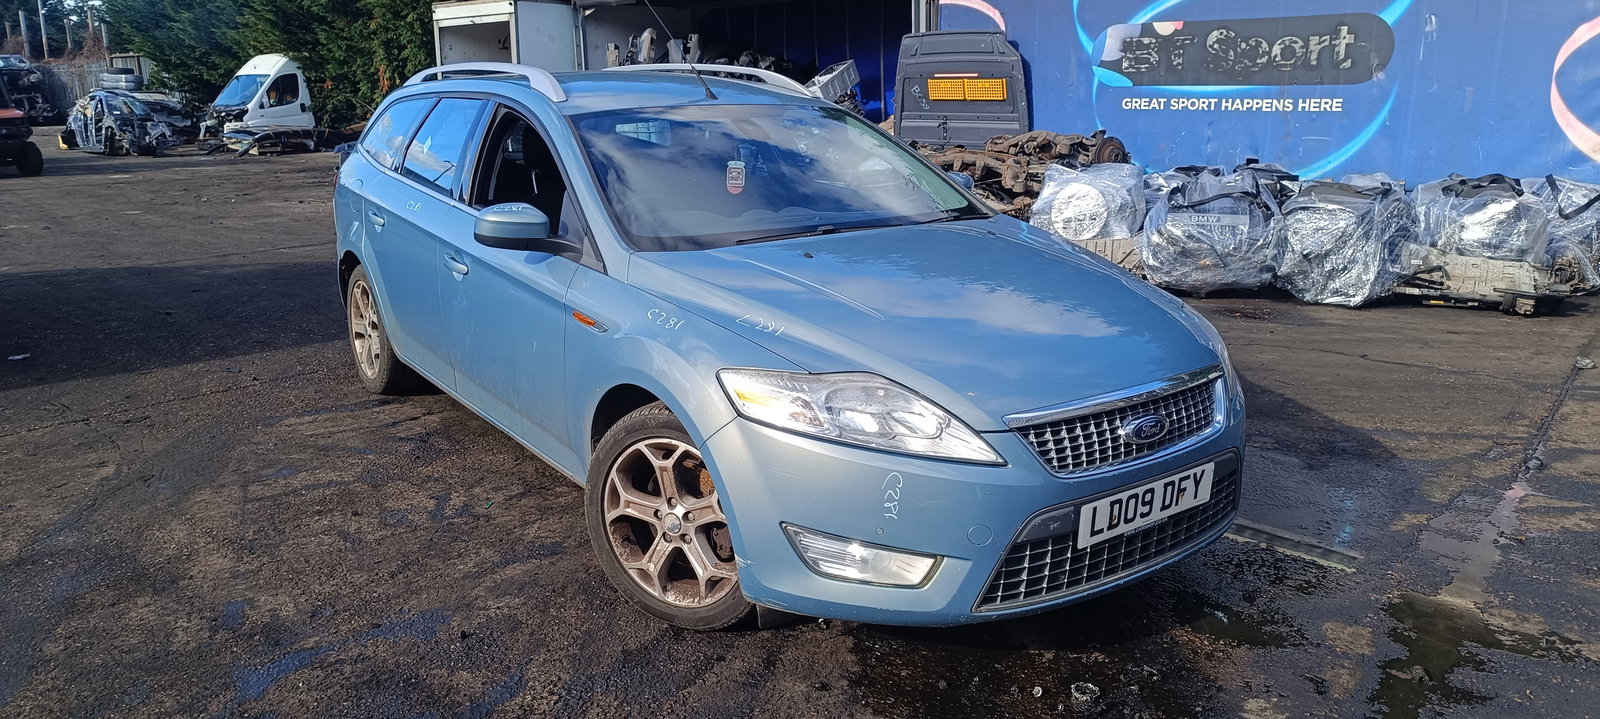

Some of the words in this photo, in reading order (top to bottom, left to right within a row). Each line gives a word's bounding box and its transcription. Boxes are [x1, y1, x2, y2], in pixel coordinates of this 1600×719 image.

[1204, 26, 1356, 80] Sport
[1121, 98, 1167, 110] GREAT
[1170, 98, 1218, 111] SPORT
[1221, 98, 1294, 112] HAPPENS
[1298, 98, 1343, 112] HERE
[647, 308, 685, 330] C281
[1141, 421, 1161, 438] Ford
[1089, 487, 1156, 538] LD09
[1159, 469, 1206, 512] DFY
